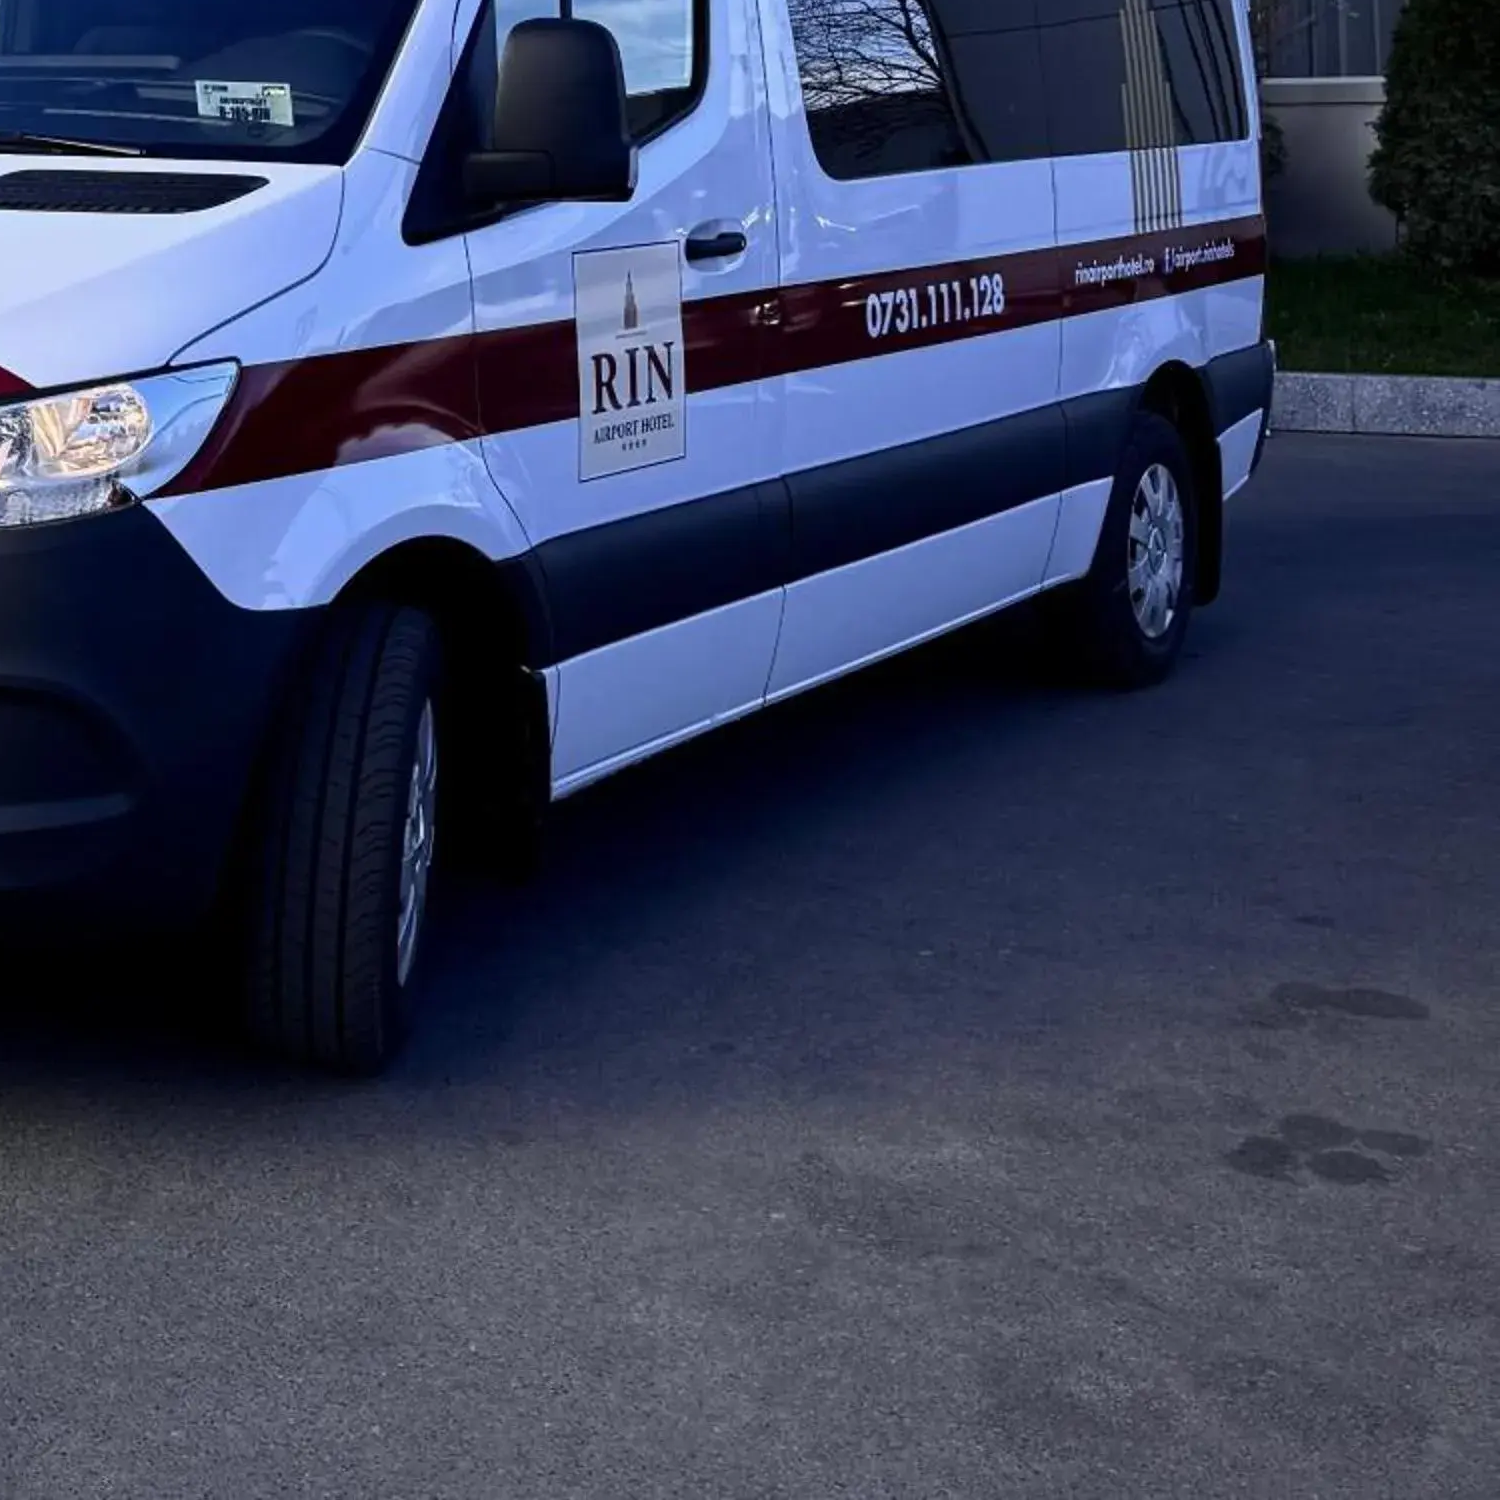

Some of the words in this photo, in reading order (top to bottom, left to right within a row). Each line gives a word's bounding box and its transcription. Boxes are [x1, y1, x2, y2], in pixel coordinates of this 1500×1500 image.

[866, 273, 1005, 339] 0731.111.128
[591, 341, 675, 416] RIN
[594, 419, 639, 445] AIRPORT
[640, 412, 675, 433] HOTEL
